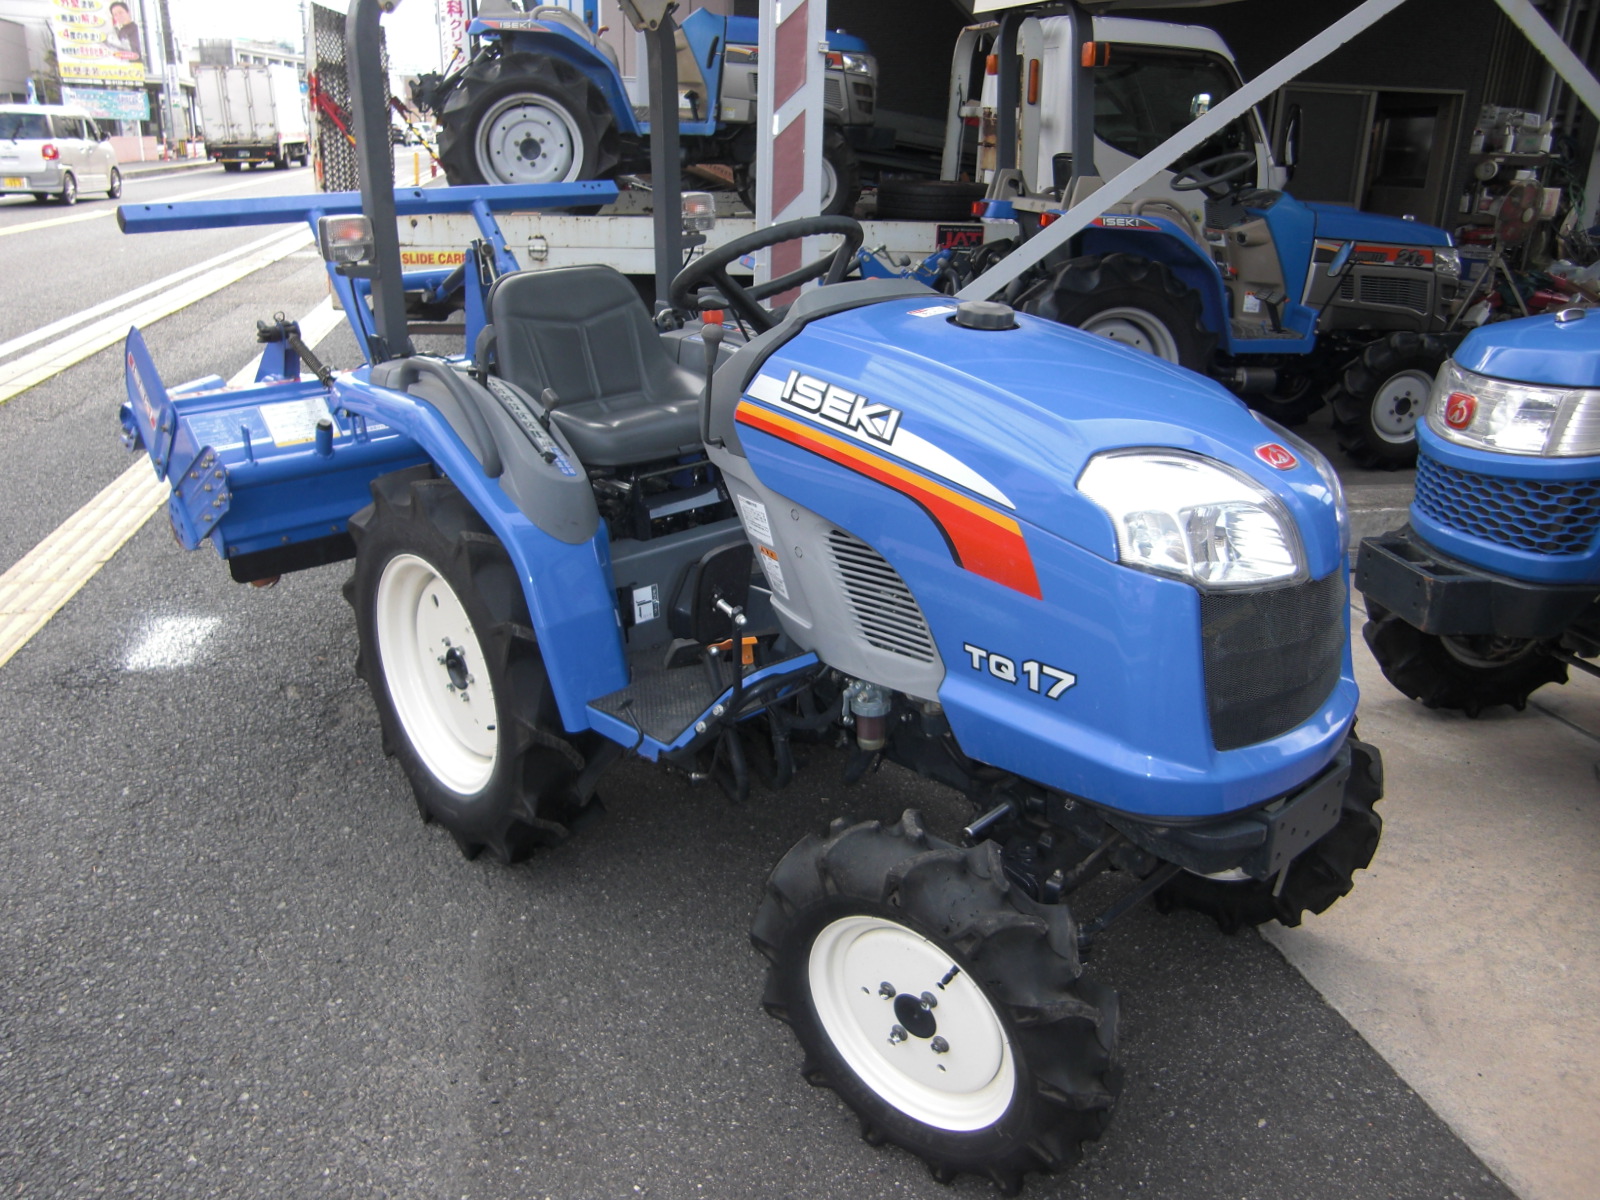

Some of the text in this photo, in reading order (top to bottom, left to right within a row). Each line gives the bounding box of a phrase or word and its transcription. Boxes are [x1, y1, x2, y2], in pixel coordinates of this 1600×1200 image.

[499, 21, 531, 29] ISEKI
[1102, 217, 1140, 227] ISEKI
[402, 252, 435, 265] SLIDE
[780, 369, 903, 446] ISEKI
